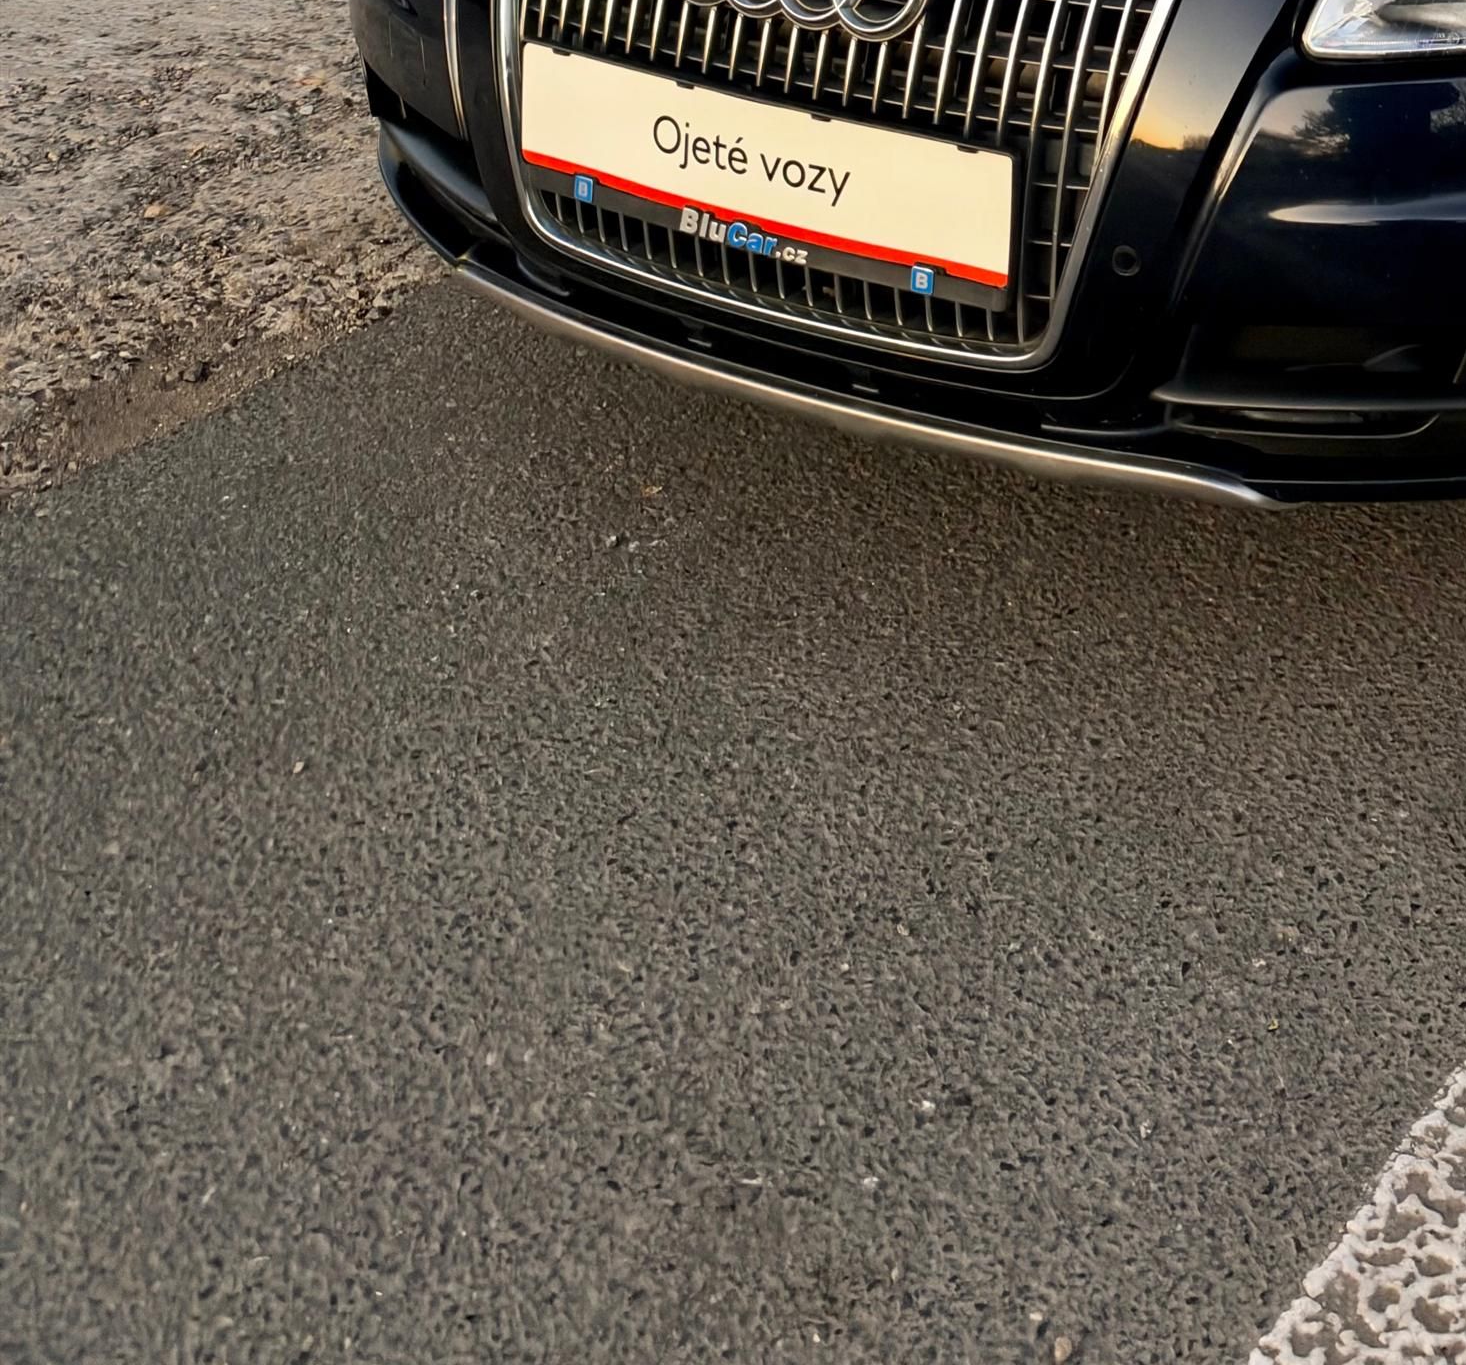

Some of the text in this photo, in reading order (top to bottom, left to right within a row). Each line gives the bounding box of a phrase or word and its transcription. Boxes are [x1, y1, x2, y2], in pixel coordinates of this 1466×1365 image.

[653, 115, 851, 207] Ojeté vozy
[679, 207, 809, 265] BluCar.cz
[915, 271, 929, 290] B
